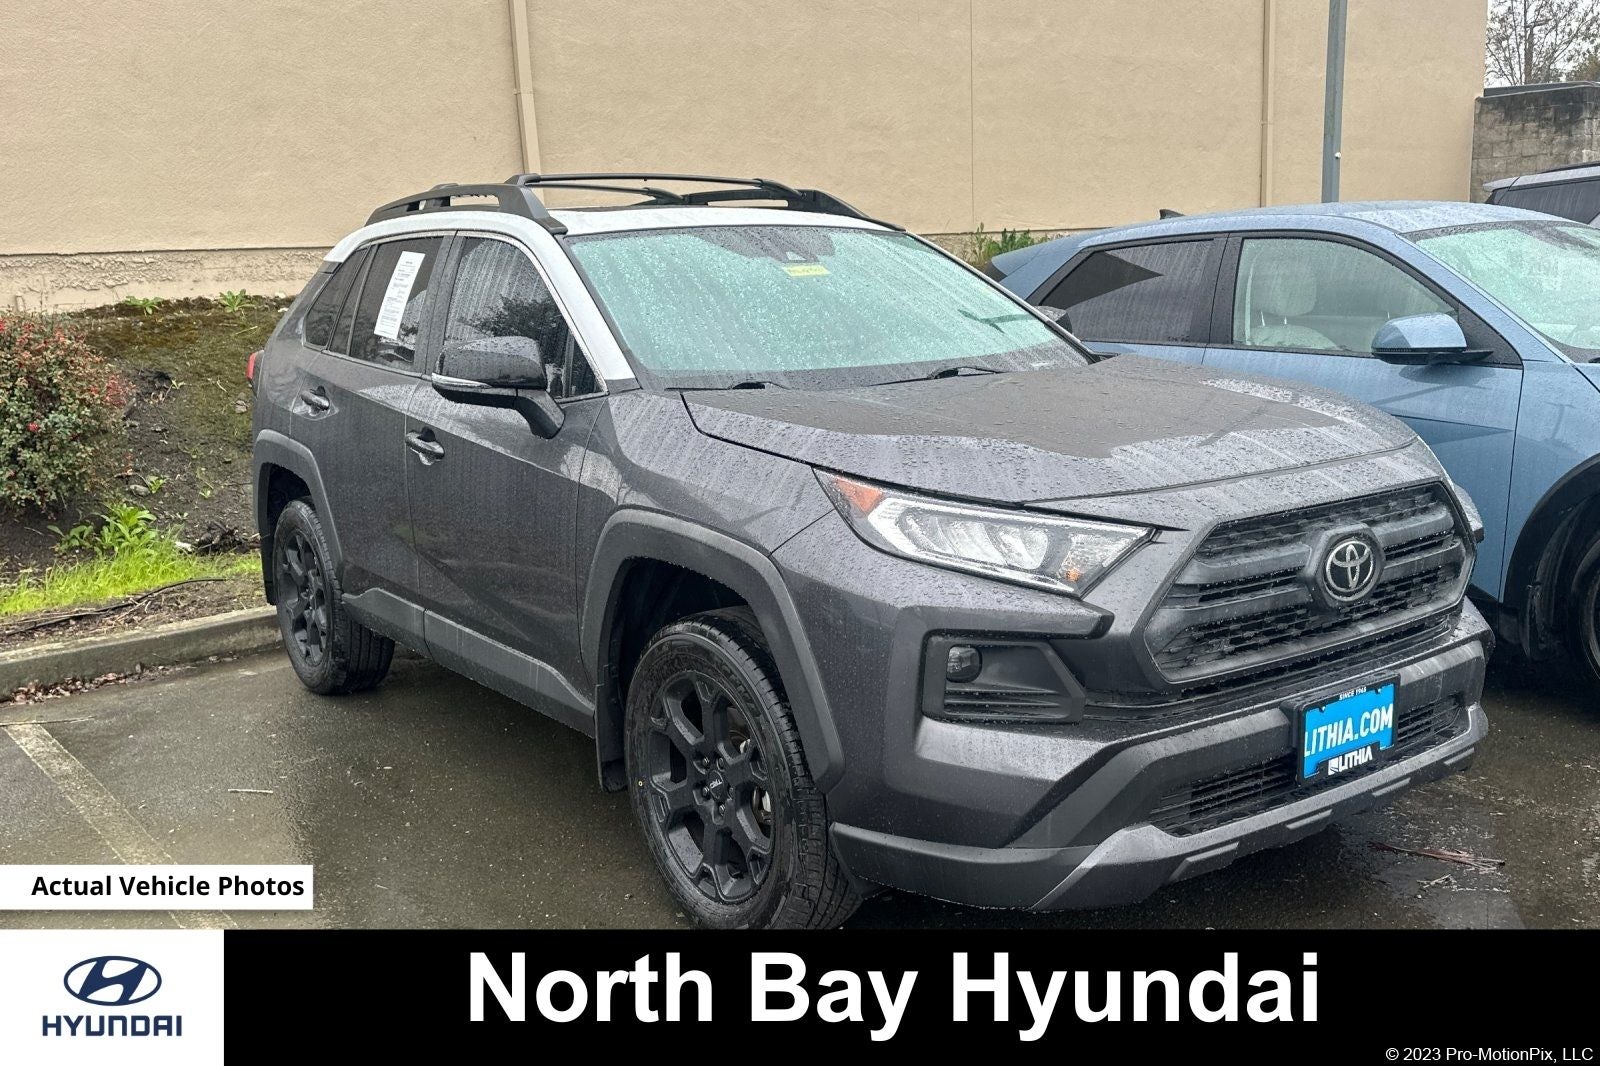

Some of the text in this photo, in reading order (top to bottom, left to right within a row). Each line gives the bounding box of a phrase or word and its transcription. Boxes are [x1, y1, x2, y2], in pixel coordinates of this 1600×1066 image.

[1339, 690, 1355, 701] SINCE
[1304, 704, 1393, 757] LITHIA.COM
[1339, 746, 1373, 772] LITHIA
